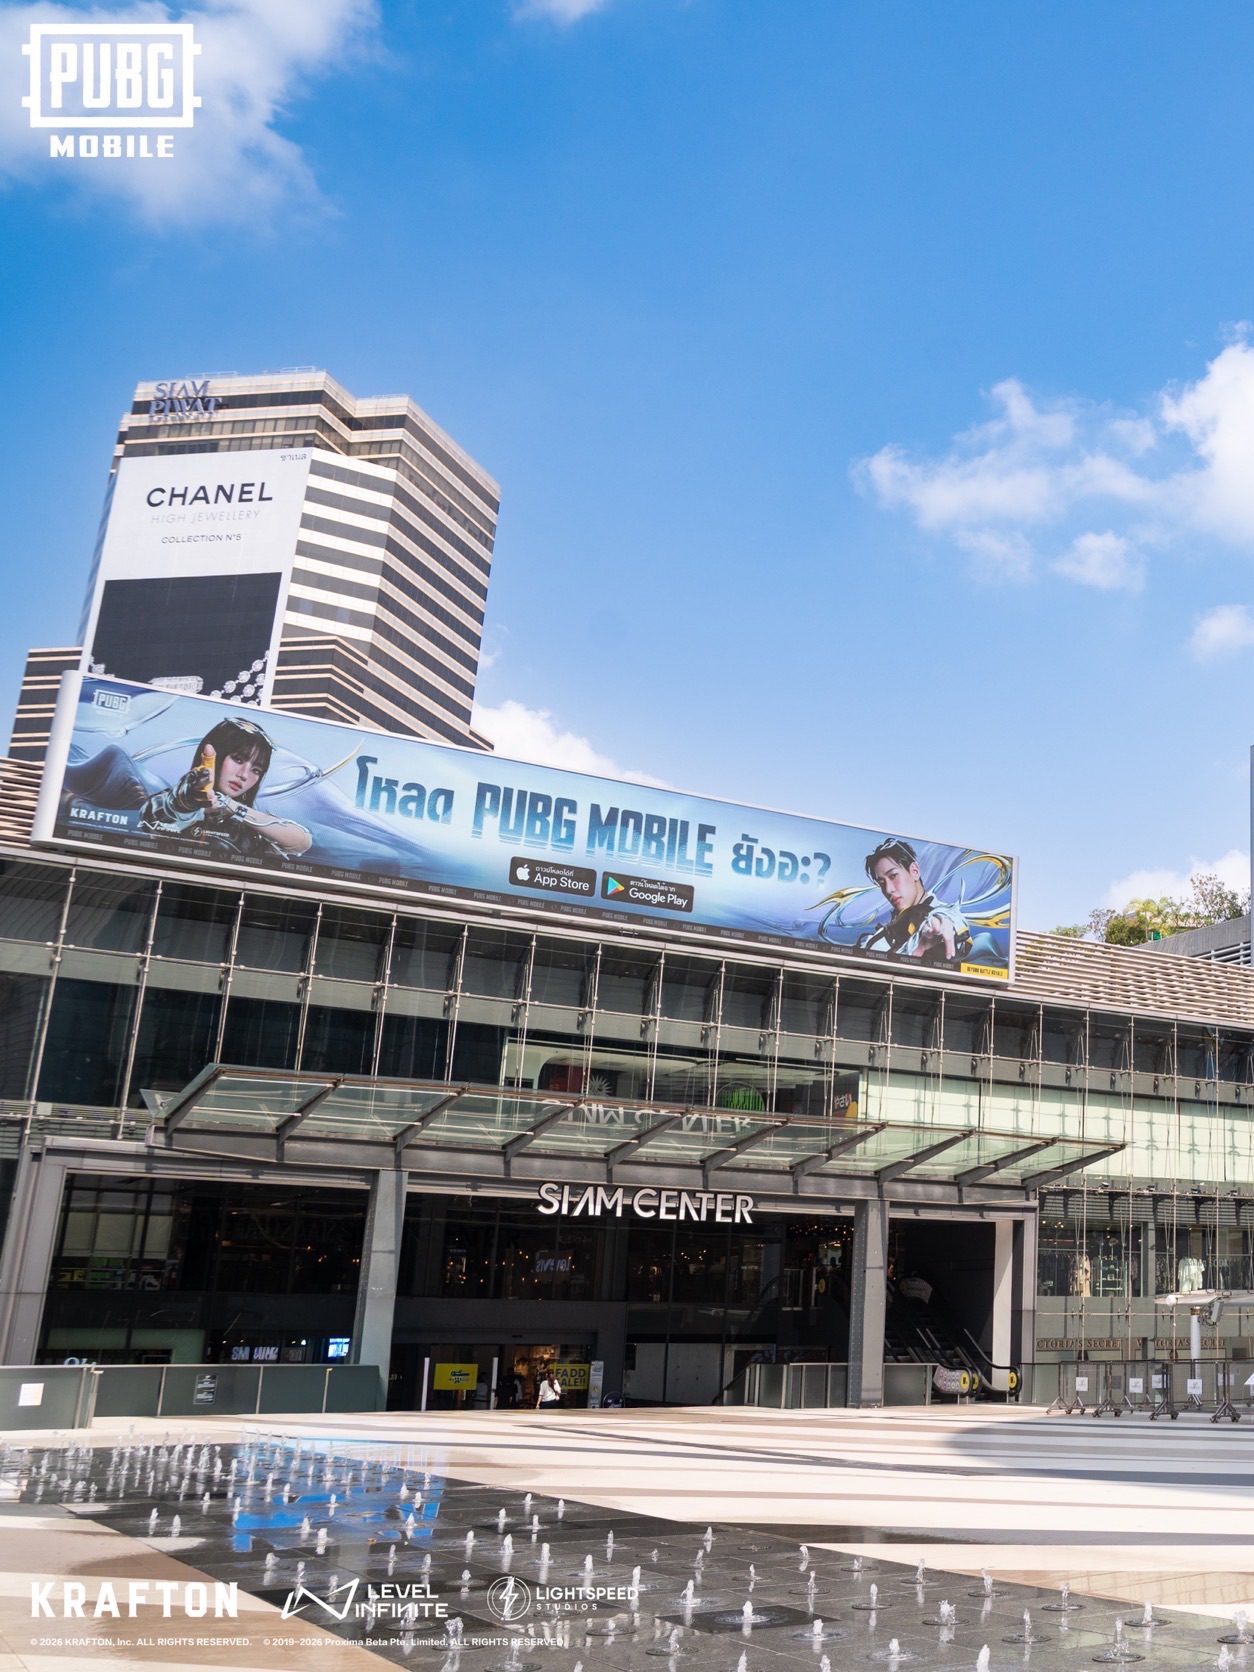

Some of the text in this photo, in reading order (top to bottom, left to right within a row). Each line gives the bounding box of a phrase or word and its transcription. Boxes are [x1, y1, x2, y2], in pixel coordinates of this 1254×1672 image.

[154, 380, 210, 399] SIAM
[149, 397, 222, 417] PIWAT
[146, 482, 273, 508] CHANEL
[151, 510, 261, 524] HIGH JEWELLERY
[161, 534, 223, 544] COLLECTION
[98, 693, 127, 710] PUBG
[70, 808, 129, 826] KRAFTON
[354, 755, 455, 825] โหลด
[471, 782, 578, 854] PUBG
[585, 803, 716, 878] MOBILE
[533, 873, 590, 891] App Store
[629, 887, 688, 908] Google Play
[537, 1182, 754, 1224] SIAM CENTER
[1036, 1338, 1123, 1348] CTORIA'S SECRET
[1200, 1338, 1227, 1347] ECRET
[555, 1368, 586, 1378] FADD
